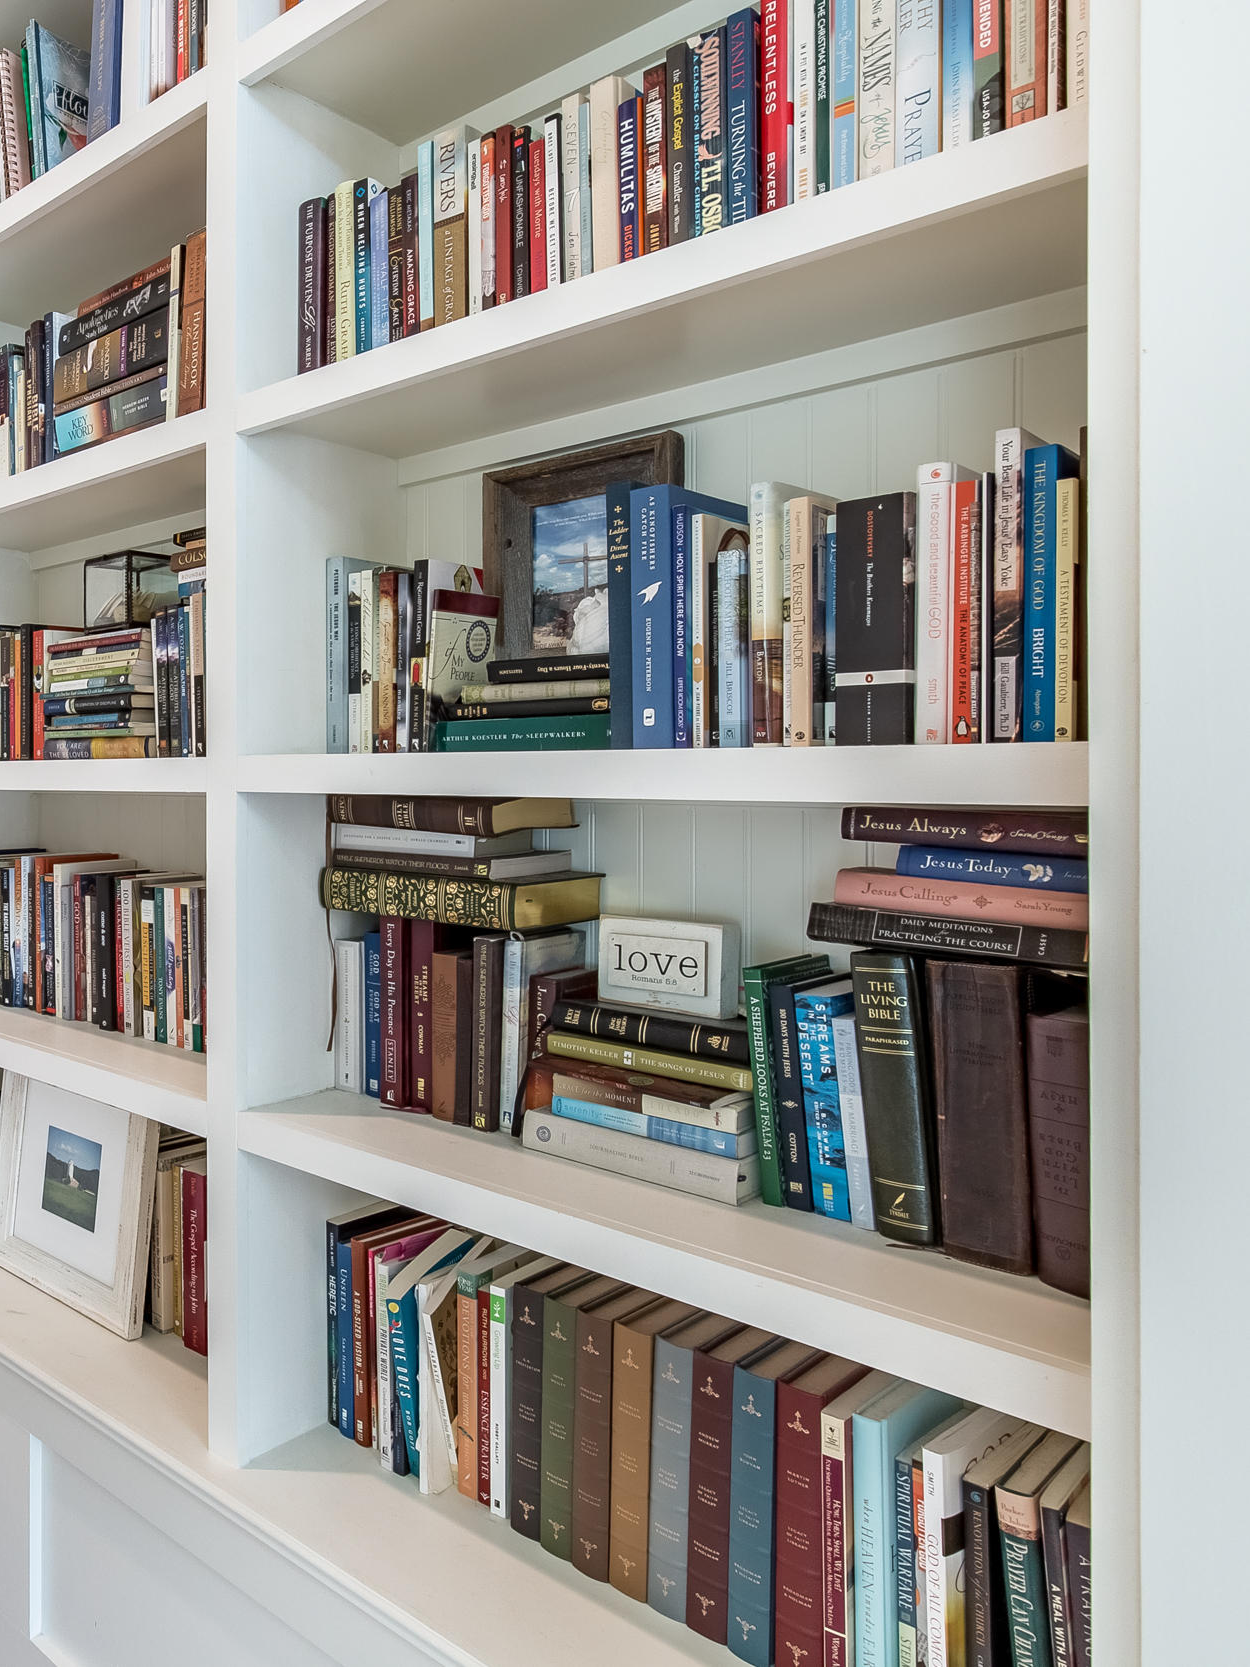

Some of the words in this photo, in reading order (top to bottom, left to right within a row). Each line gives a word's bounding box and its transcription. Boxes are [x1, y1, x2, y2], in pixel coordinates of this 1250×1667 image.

[731, 20, 746, 90] STANLEY
[765, 0, 776, 115] RELENTLESS
[818, 18, 826, 64] CHRISTMAS
[861, 26, 892, 92] NAMES
[672, 69, 681, 82] the
[818, 65, 826, 101] PROMISE
[1076, 30, 1088, 102] GLADWELL
[672, 82, 684, 115] Explicit
[695, 36, 721, 140] SOULWINNING
[646, 98, 662, 145] MYSTERY
[672, 116, 684, 150] Gospel
[566, 122, 578, 166] SEVEN
[731, 100, 746, 180] TURNING
[440, 141, 456, 213] RIVERS
[532, 149, 545, 186] tuesdays
[620, 119, 634, 214] HUMILITAS
[673, 162, 683, 202] Chandler
[766, 152, 776, 209] BEVERE
[534, 189, 545, 208] with
[733, 182, 743, 196] the
[357, 202, 365, 230] WHEN
[515, 174, 524, 248] UNFASHIONABLE
[534, 209, 545, 238] Morrie
[304, 222, 314, 264] PURPOSE
[358, 234, 366, 274] HELPING
[304, 266, 313, 303] DRIVEN
[406, 249, 414, 292] AMAZING
[340, 280, 350, 316] RUTH
[407, 295, 415, 324] GRACE
[190, 310, 200, 389] HANDBOOK
[1001, 440, 1013, 462] Your
[1001, 465, 1013, 482] Best
[1033, 460, 1046, 488] THE
[1001, 485, 1013, 503] Life
[608, 526, 630, 536] Ladder
[960, 506, 969, 520] THE
[1032, 492, 1046, 554] KINGDOM
[756, 512, 764, 556] SACRED
[960, 523, 968, 564] ARBINGER
[1000, 542, 1012, 564] Easy
[1032, 557, 1045, 576] OF
[756, 560, 764, 615] RHYTHMS
[792, 563, 806, 614] REVERSED
[960, 566, 968, 605] INSTITUTE
[1001, 566, 1012, 587] Yoke
[1032, 580, 1046, 610] GOD
[1058, 578, 1069, 636] TESTAMENT
[928, 607, 941, 639] GOD
[960, 609, 968, 622] THE
[793, 616, 806, 670] THUNDER
[959, 625, 968, 663] ANATOMY
[1032, 628, 1045, 678] BRIGHT
[726, 660, 734, 678] JILL
[959, 665, 967, 678] OF
[1058, 655, 1068, 704] DEVOTION
[726, 681, 734, 714] BRISCOE
[958, 680, 966, 705] PEACE
[472, 733, 508, 742] KOESTLER
[526, 730, 587, 740] SLEEPWALKERS
[860, 815, 901, 831] Jesus
[906, 818, 968, 840] Always
[920, 855, 963, 870] Jesus
[964, 858, 1012, 878] Today
[861, 882, 897, 896] Jesus
[1014, 900, 1042, 910] Sarah
[1042, 902, 1072, 916] Young
[386, 923, 395, 948] Every
[878, 930, 942, 944] PRACTICING
[945, 936, 966, 946] THE
[968, 938, 1014, 952] COURSE
[900, 918, 926, 928] DAILY
[928, 920, 994, 934] MEDITATIONS
[386, 950, 396, 968] Day
[613, 943, 699, 979] love
[1038, 933, 1047, 956] CASEY
[388, 981, 396, 996] His
[631, 974, 664, 985] Romans
[868, 980, 896, 992] THE
[388, 998, 396, 1036] Presence
[860, 994, 908, 1008] LIVING
[868, 1008, 902, 1020] BIBLE
[751, 1006, 766, 1061] SHEPHERD
[798, 1021, 814, 1080] DESERT
[815, 1004, 831, 1074] STREAMS
[864, 1036, 910, 1046] PARAPHRASED
[552, 1041, 587, 1053] TIMOTHY
[589, 1048, 618, 1060] KELLER
[658, 1062, 683, 1072] SONGS
[698, 1067, 726, 1080] JESUS
[756, 1063, 768, 1098] LOOKS
[759, 1100, 769, 1112] AT
[782, 1059, 791, 1078] JESUS
[789, 1132, 798, 1163] COTTON
[760, 1114, 772, 1148] PSALM
[820, 1123, 831, 1166] COWMAN
[328, 1274, 336, 1316] HERETIC
[340, 1268, 348, 1312] UNSEEN
[354, 1298, 362, 1339] GOD-SIZED
[462, 1300, 470, 1370] DEVOTIONS
[380, 1328, 388, 1356] PRIVATE
[392, 1329, 406, 1360] LOVE
[380, 1357, 388, 1381] WORLD
[397, 1366, 410, 1398] DOES
[480, 1390, 489, 1431] ESSENCE
[480, 1438, 489, 1480] PRAYER
[896, 1472, 912, 1542] SPIRITUAL
[861, 1526, 874, 1591] HEAVEN
[926, 1534, 939, 1567] GOD
[972, 1510, 983, 1576] RENOVATION
[898, 1547, 912, 1611] WARFARE
[1004, 1538, 1028, 1593] PRAYER
[974, 1603, 985, 1647] CHURCH
[1010, 1594, 1034, 1626] CAN
[1052, 1594, 1062, 1622] MEAL
[1055, 1626, 1064, 1653] WITH
